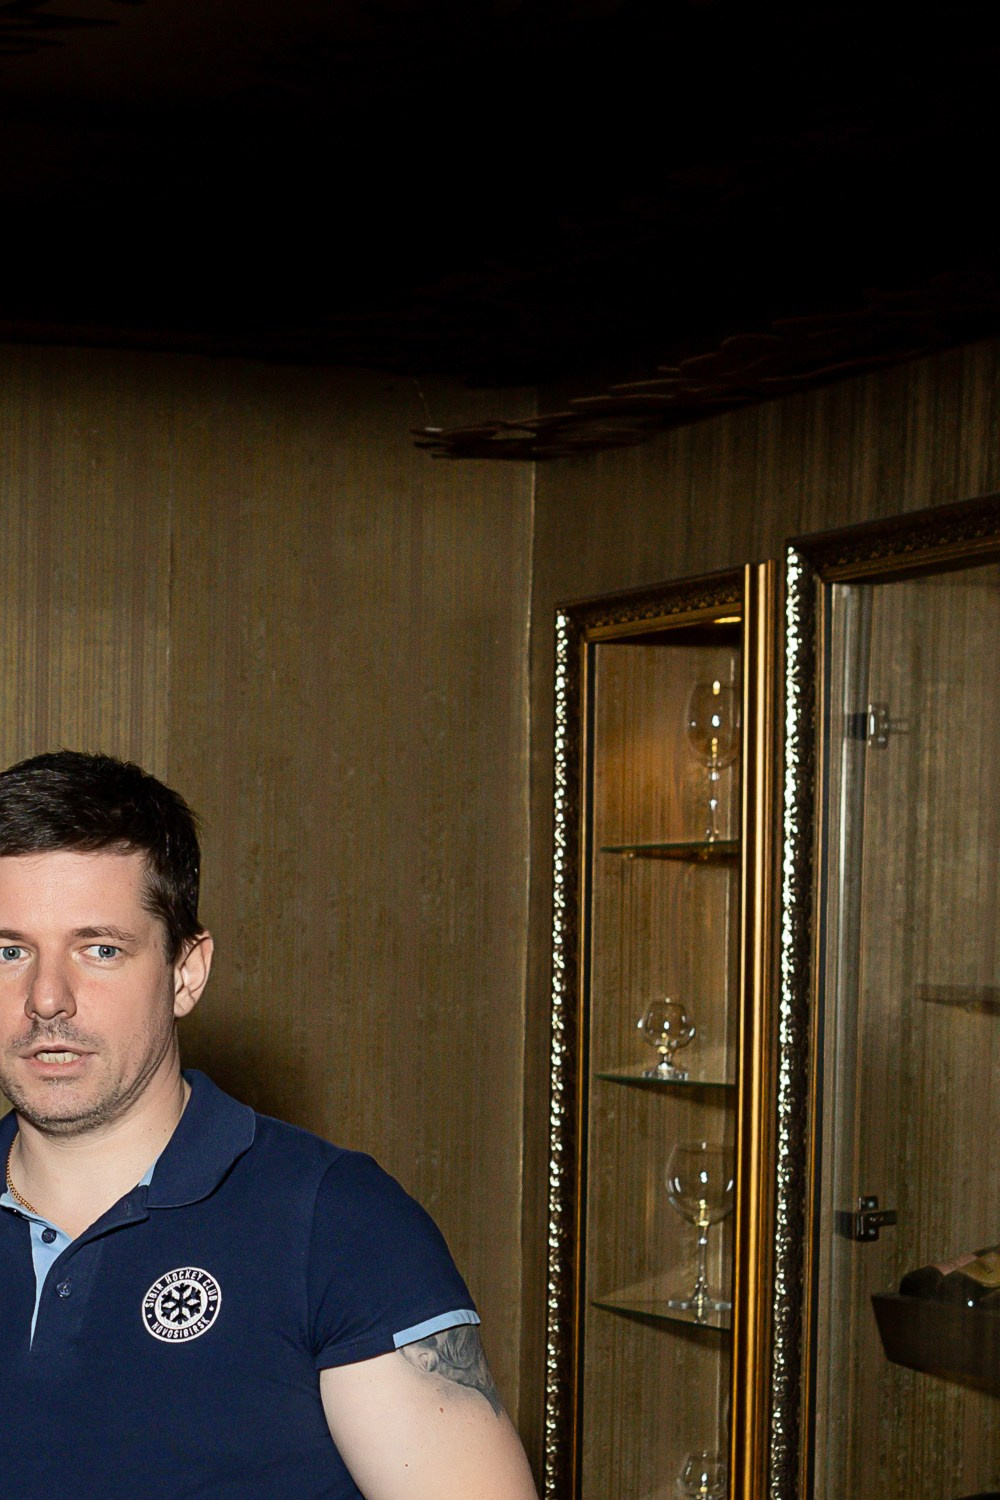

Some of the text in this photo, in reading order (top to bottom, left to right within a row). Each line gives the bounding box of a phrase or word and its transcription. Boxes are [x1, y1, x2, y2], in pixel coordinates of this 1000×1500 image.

[145, 1269, 218, 1308] SIBIR HOCKEY CLUB
[151, 1316, 210, 1338] NOVOSIBIRSK
